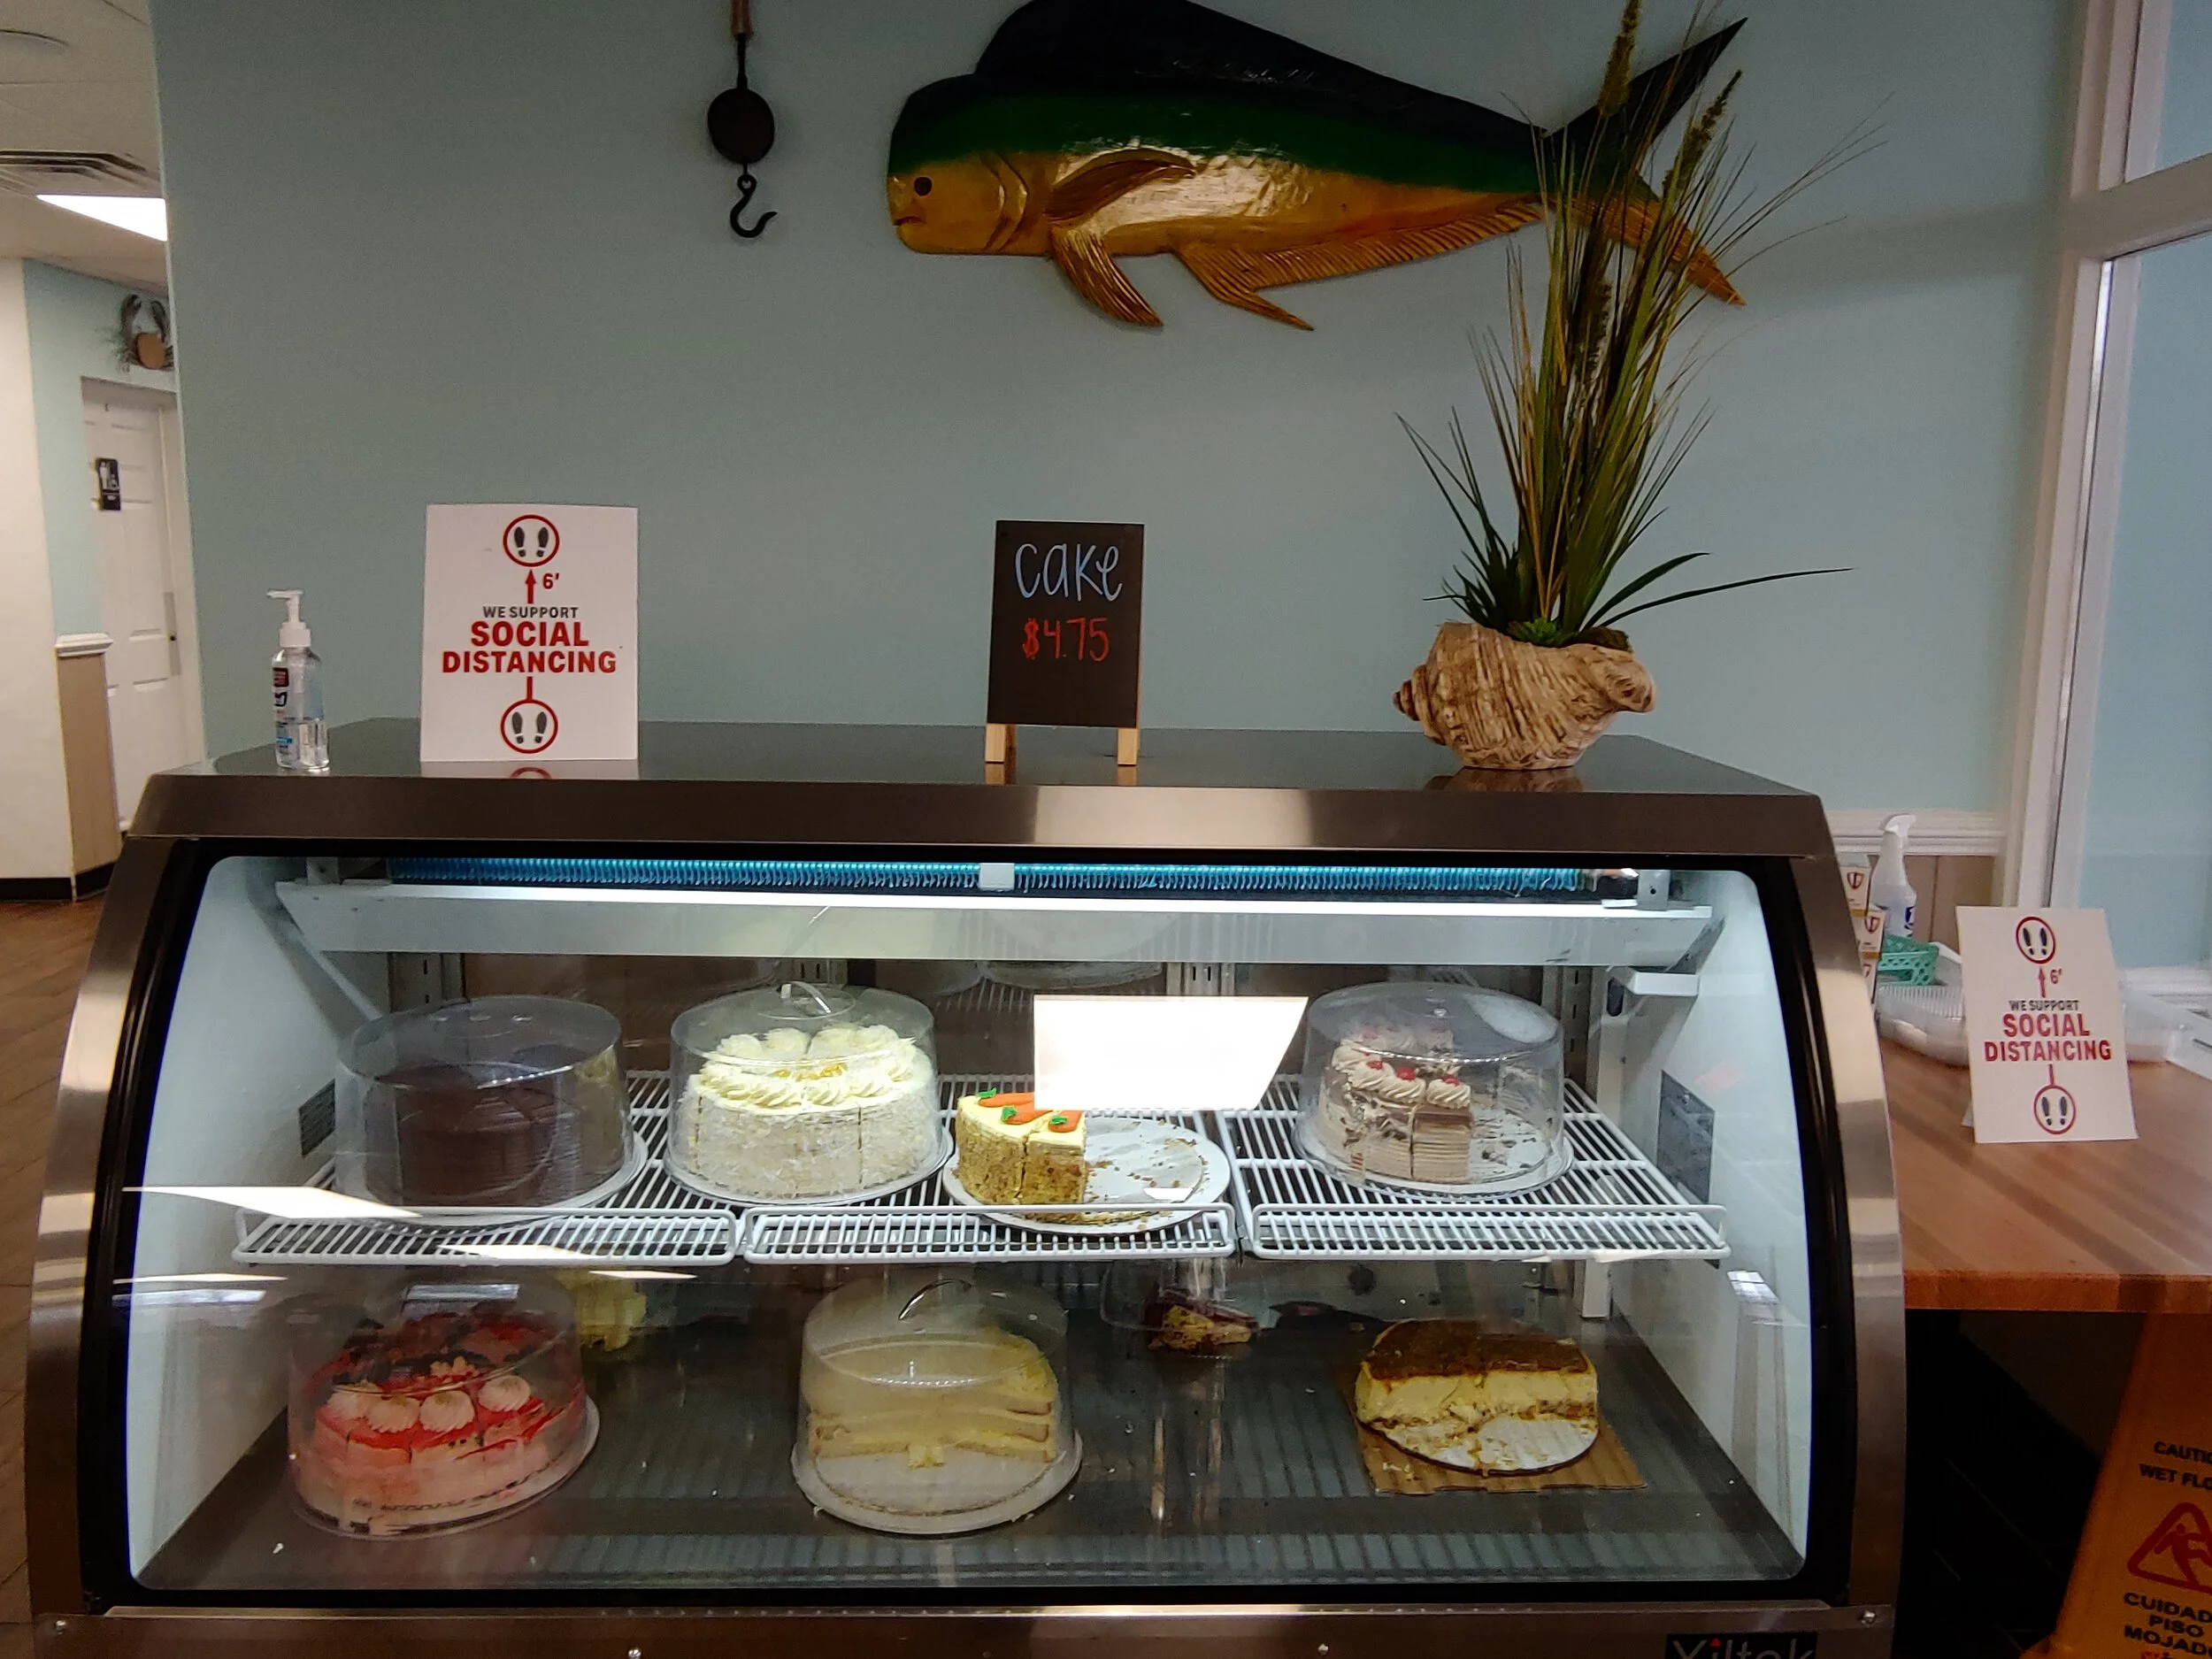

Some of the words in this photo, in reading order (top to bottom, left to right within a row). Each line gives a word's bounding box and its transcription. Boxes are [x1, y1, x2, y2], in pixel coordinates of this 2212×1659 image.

[541, 572, 560, 590] 6'
[483, 606, 506, 618] WE
[510, 606, 579, 618] SUPPORT
[471, 620, 589, 648] SOCIAL
[442, 650, 617, 674] DISTANCING
[2008, 1000, 2027, 1011] WE
[2030, 1000, 2079, 1011] SUPPORT
[2002, 1013, 2091, 1038] SOCIAL
[1984, 1039, 2112, 1063] DISTANCING
[2139, 1463, 2177, 1483] WET
[2150, 1615, 2204, 1638] PISO
[2124, 1624, 2212, 1657] MOJAD
